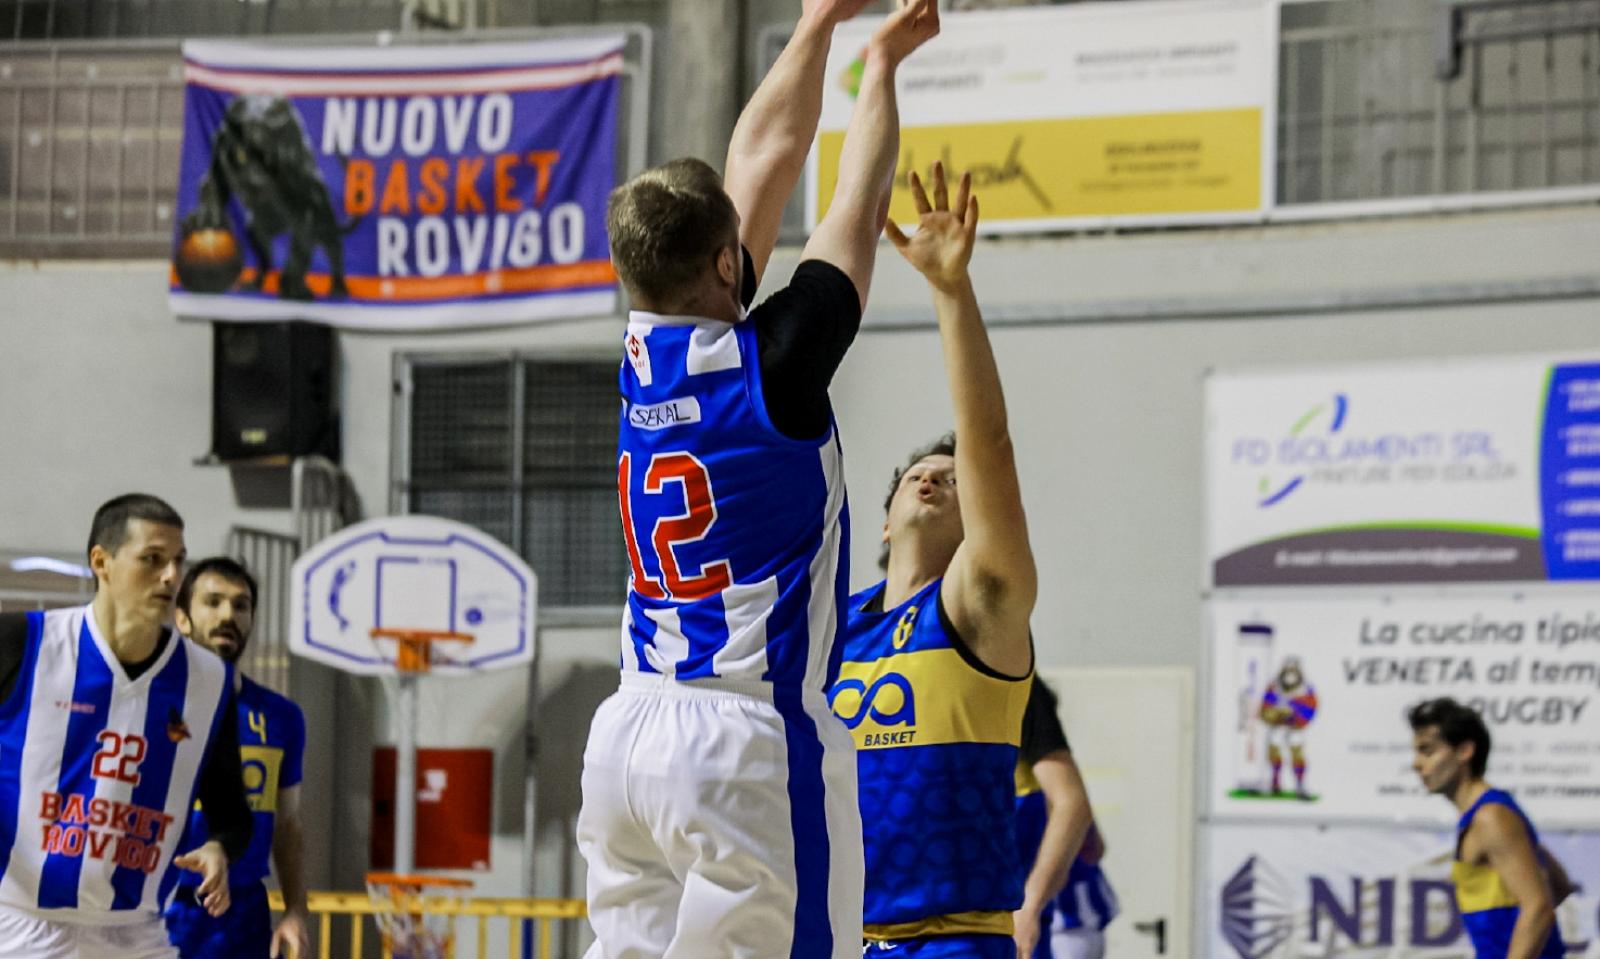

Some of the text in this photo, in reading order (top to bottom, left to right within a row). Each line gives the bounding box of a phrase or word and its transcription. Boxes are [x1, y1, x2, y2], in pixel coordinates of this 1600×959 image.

[322, 93, 515, 157] NUOVO
[344, 151, 560, 216] BASKET
[378, 203, 585, 278] ROVIGO
[631, 403, 691, 427] SEKAL
[617, 450, 733, 603] 12
[1359, 617, 1400, 646] La
[1409, 613, 1525, 646] cucina
[1343, 655, 1600, 690] VENETA al tem
[248, 710, 267, 744] 4
[864, 730, 917, 748] BASKET
[91, 728, 147, 788] 22
[39, 791, 174, 843] BASKET
[41, 824, 161, 875] ROVIGO
